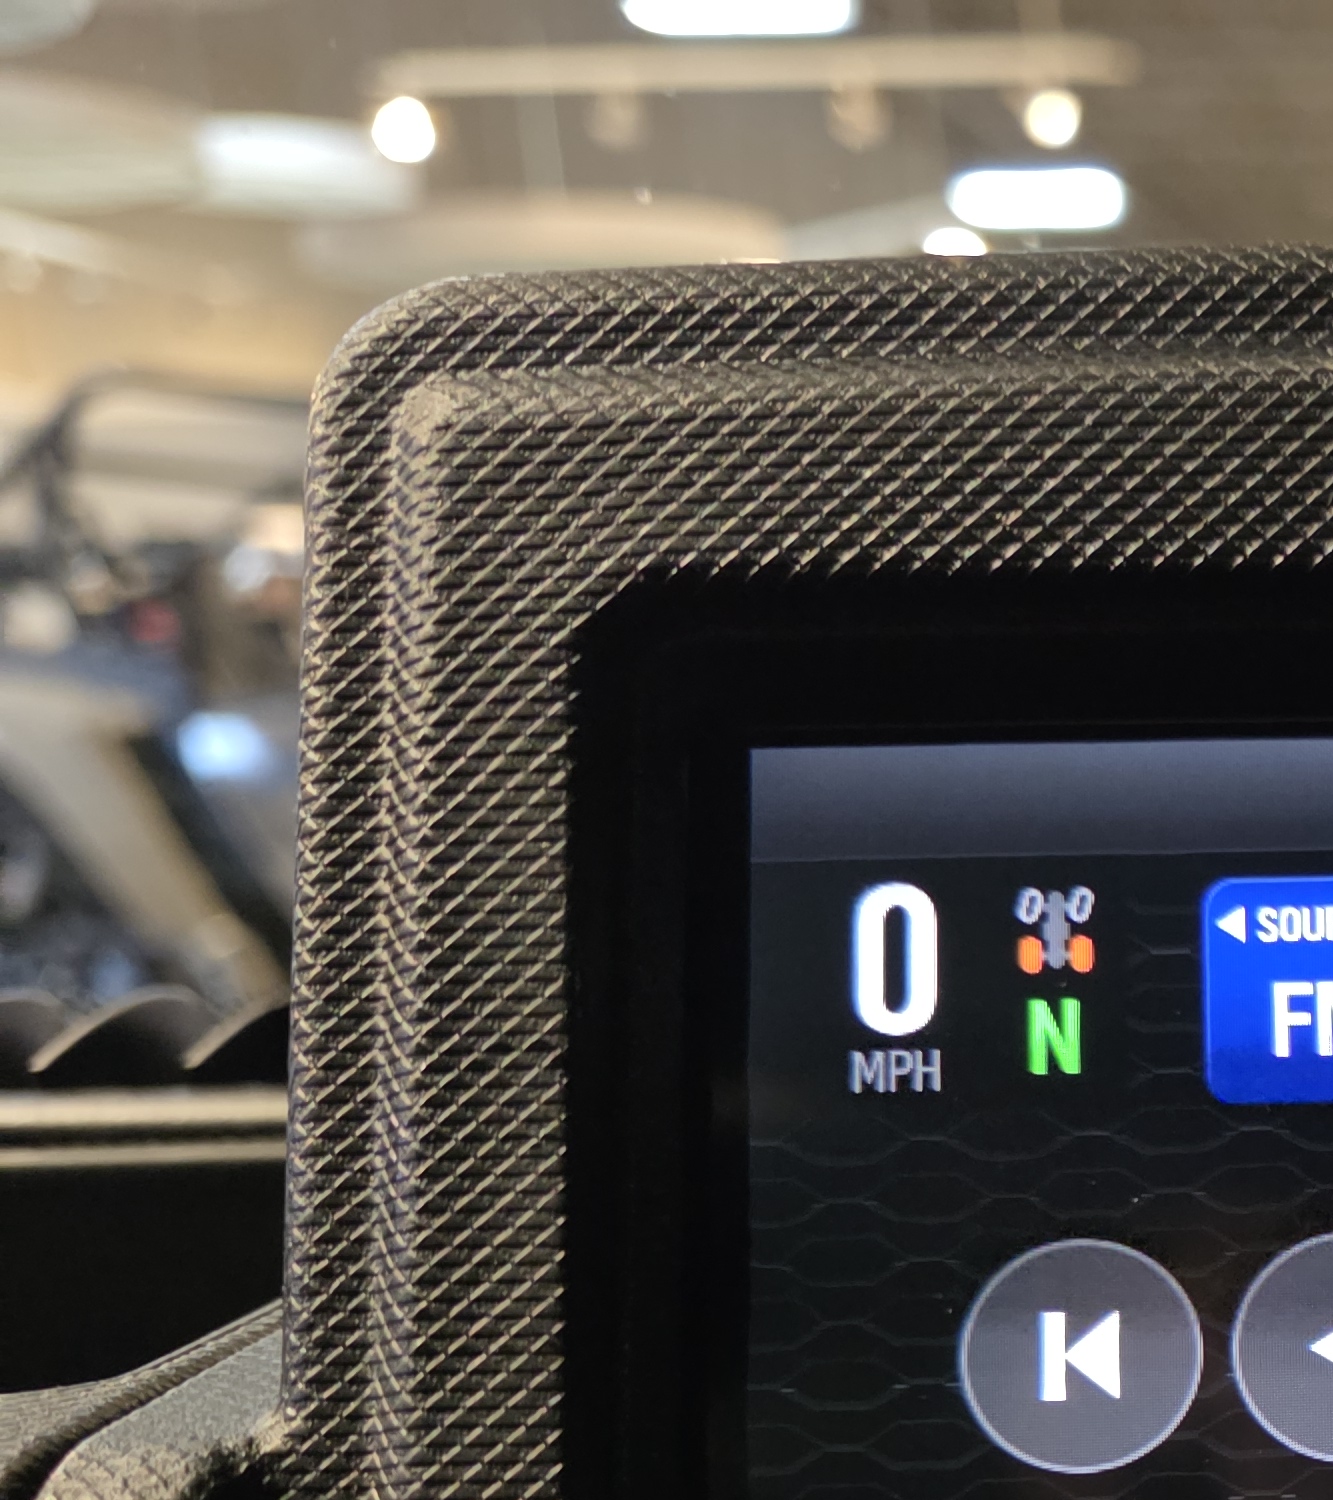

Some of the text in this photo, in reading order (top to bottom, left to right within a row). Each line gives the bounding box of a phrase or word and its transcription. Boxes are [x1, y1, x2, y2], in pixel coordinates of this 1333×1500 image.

[854, 881, 939, 1038] 0
[851, 1048, 943, 1095] MPH
[1026, 996, 1082, 1077] N
